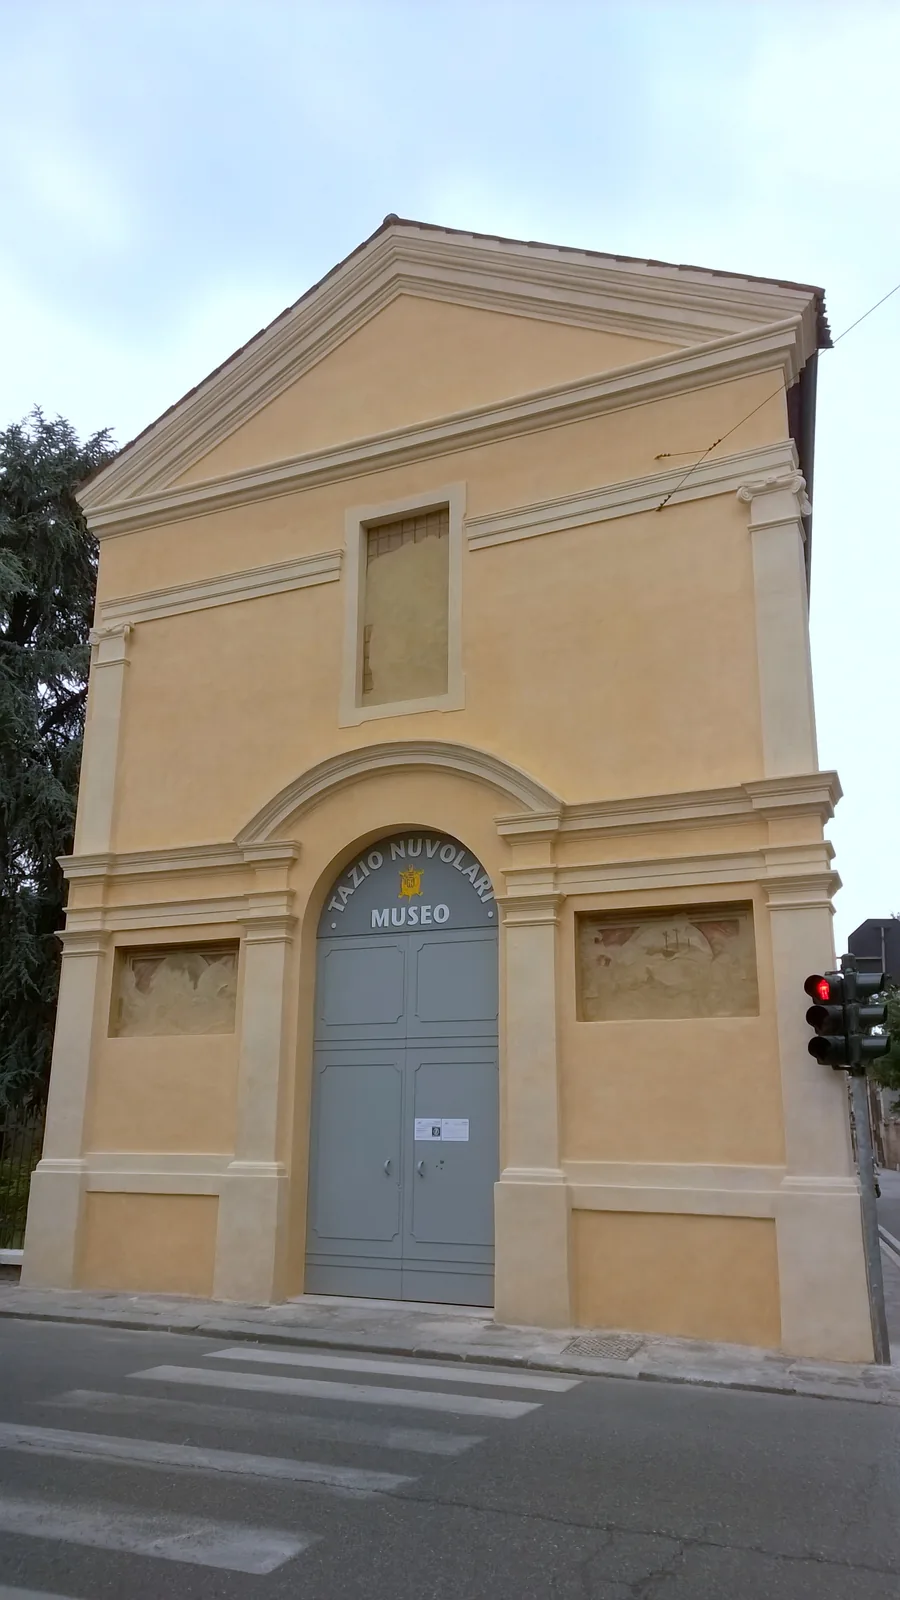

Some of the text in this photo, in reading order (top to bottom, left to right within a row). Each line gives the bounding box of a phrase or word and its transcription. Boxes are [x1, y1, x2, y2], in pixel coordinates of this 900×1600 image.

[328, 838, 495, 912] TAZIO NUVOLARI
[371, 904, 450, 928] MUSEO
